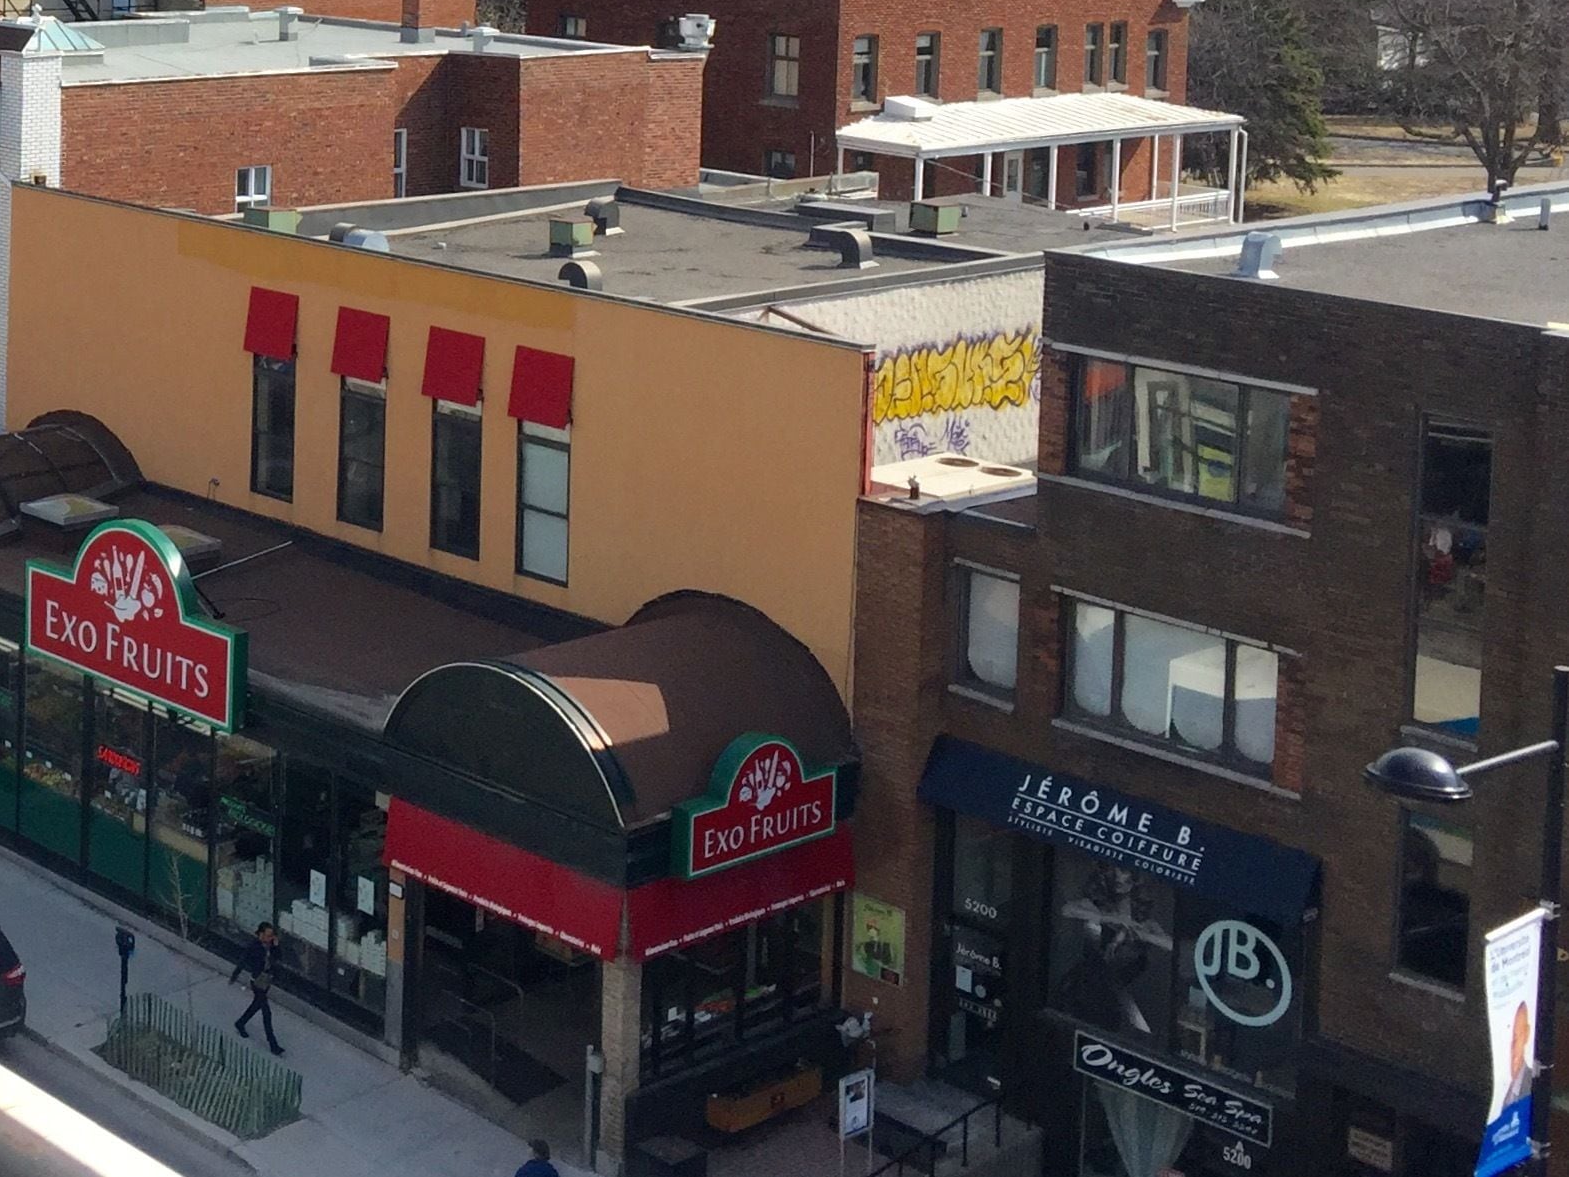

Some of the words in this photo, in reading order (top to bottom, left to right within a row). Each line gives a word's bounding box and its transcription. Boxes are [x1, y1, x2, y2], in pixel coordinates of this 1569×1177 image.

[45, 599, 97, 653] EXO
[106, 622, 209, 698] FRUITS
[704, 825, 744, 858] EXO
[750, 800, 822, 844] FRUITS
[1011, 797, 1085, 832] ESPACE
[1097, 826, 1203, 871] COIFFURE
[1018, 774, 1154, 833] JÉRÔME
[1176, 825, 1206, 852] B.
[1007, 816, 1053, 837] STYLISTE
[1068, 836, 1124, 861] VISAGISTE
[1134, 859, 1196, 886] COLORISTE
[964, 897, 998, 919] 5200
[1081, 1044, 1174, 1095] Ongles
[1223, 1100, 1263, 1125] Spa
[1222, 1147, 1252, 1170] 5200
